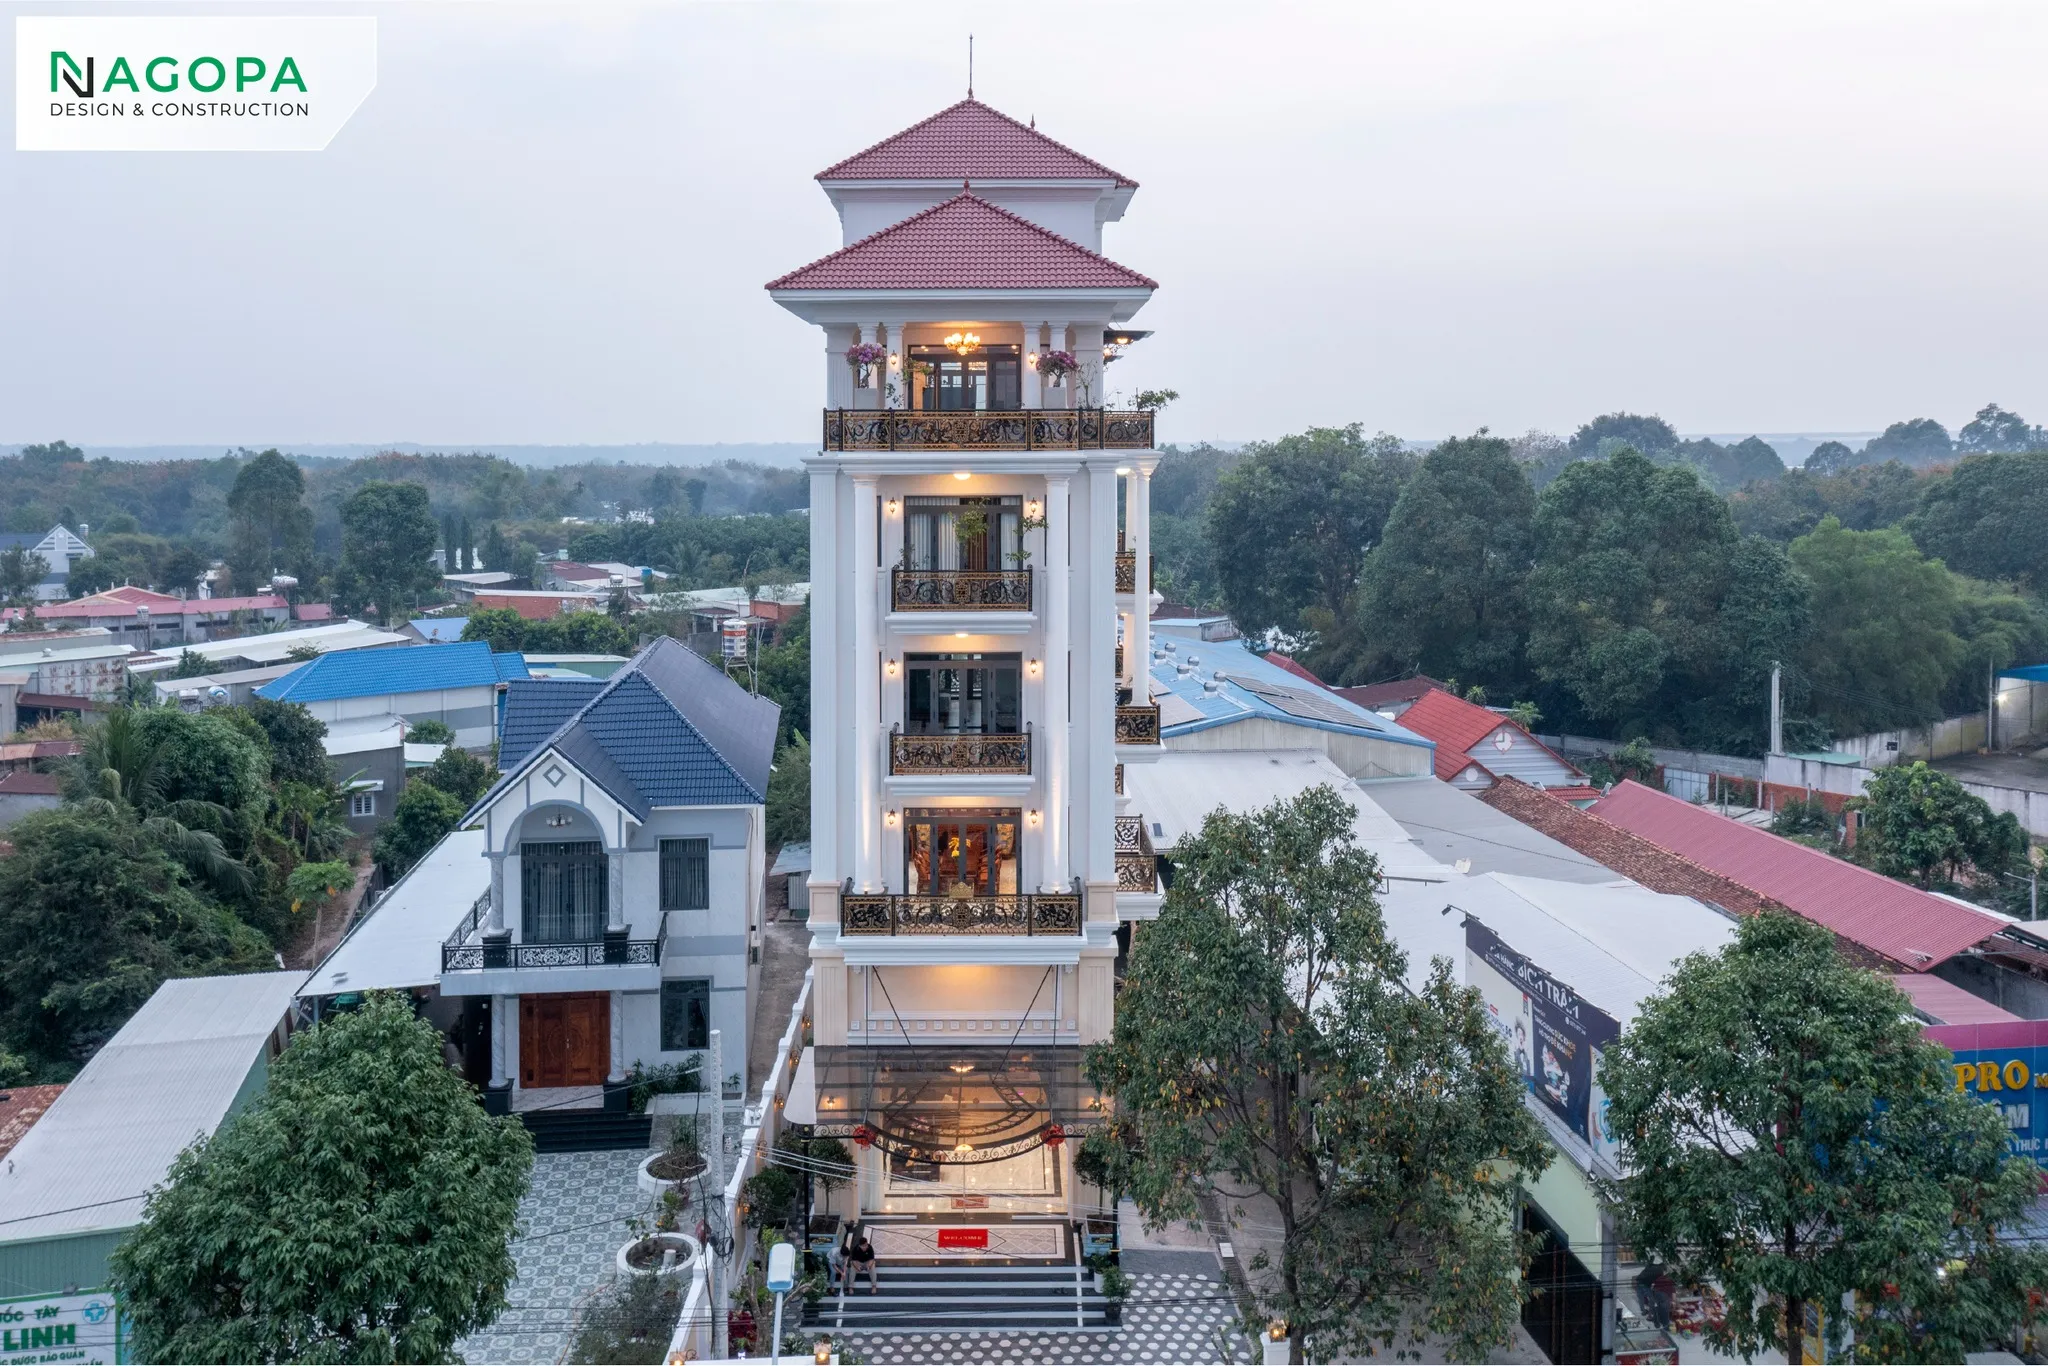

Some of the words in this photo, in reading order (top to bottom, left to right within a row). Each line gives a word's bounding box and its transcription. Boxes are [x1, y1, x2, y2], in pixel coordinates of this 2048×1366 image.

[1953, 1059, 2030, 1093] PRO
[0, 1305, 24, 1323] ỐC
[34, 1304, 60, 1319] TÂY
[3, 1324, 76, 1351] LINH
